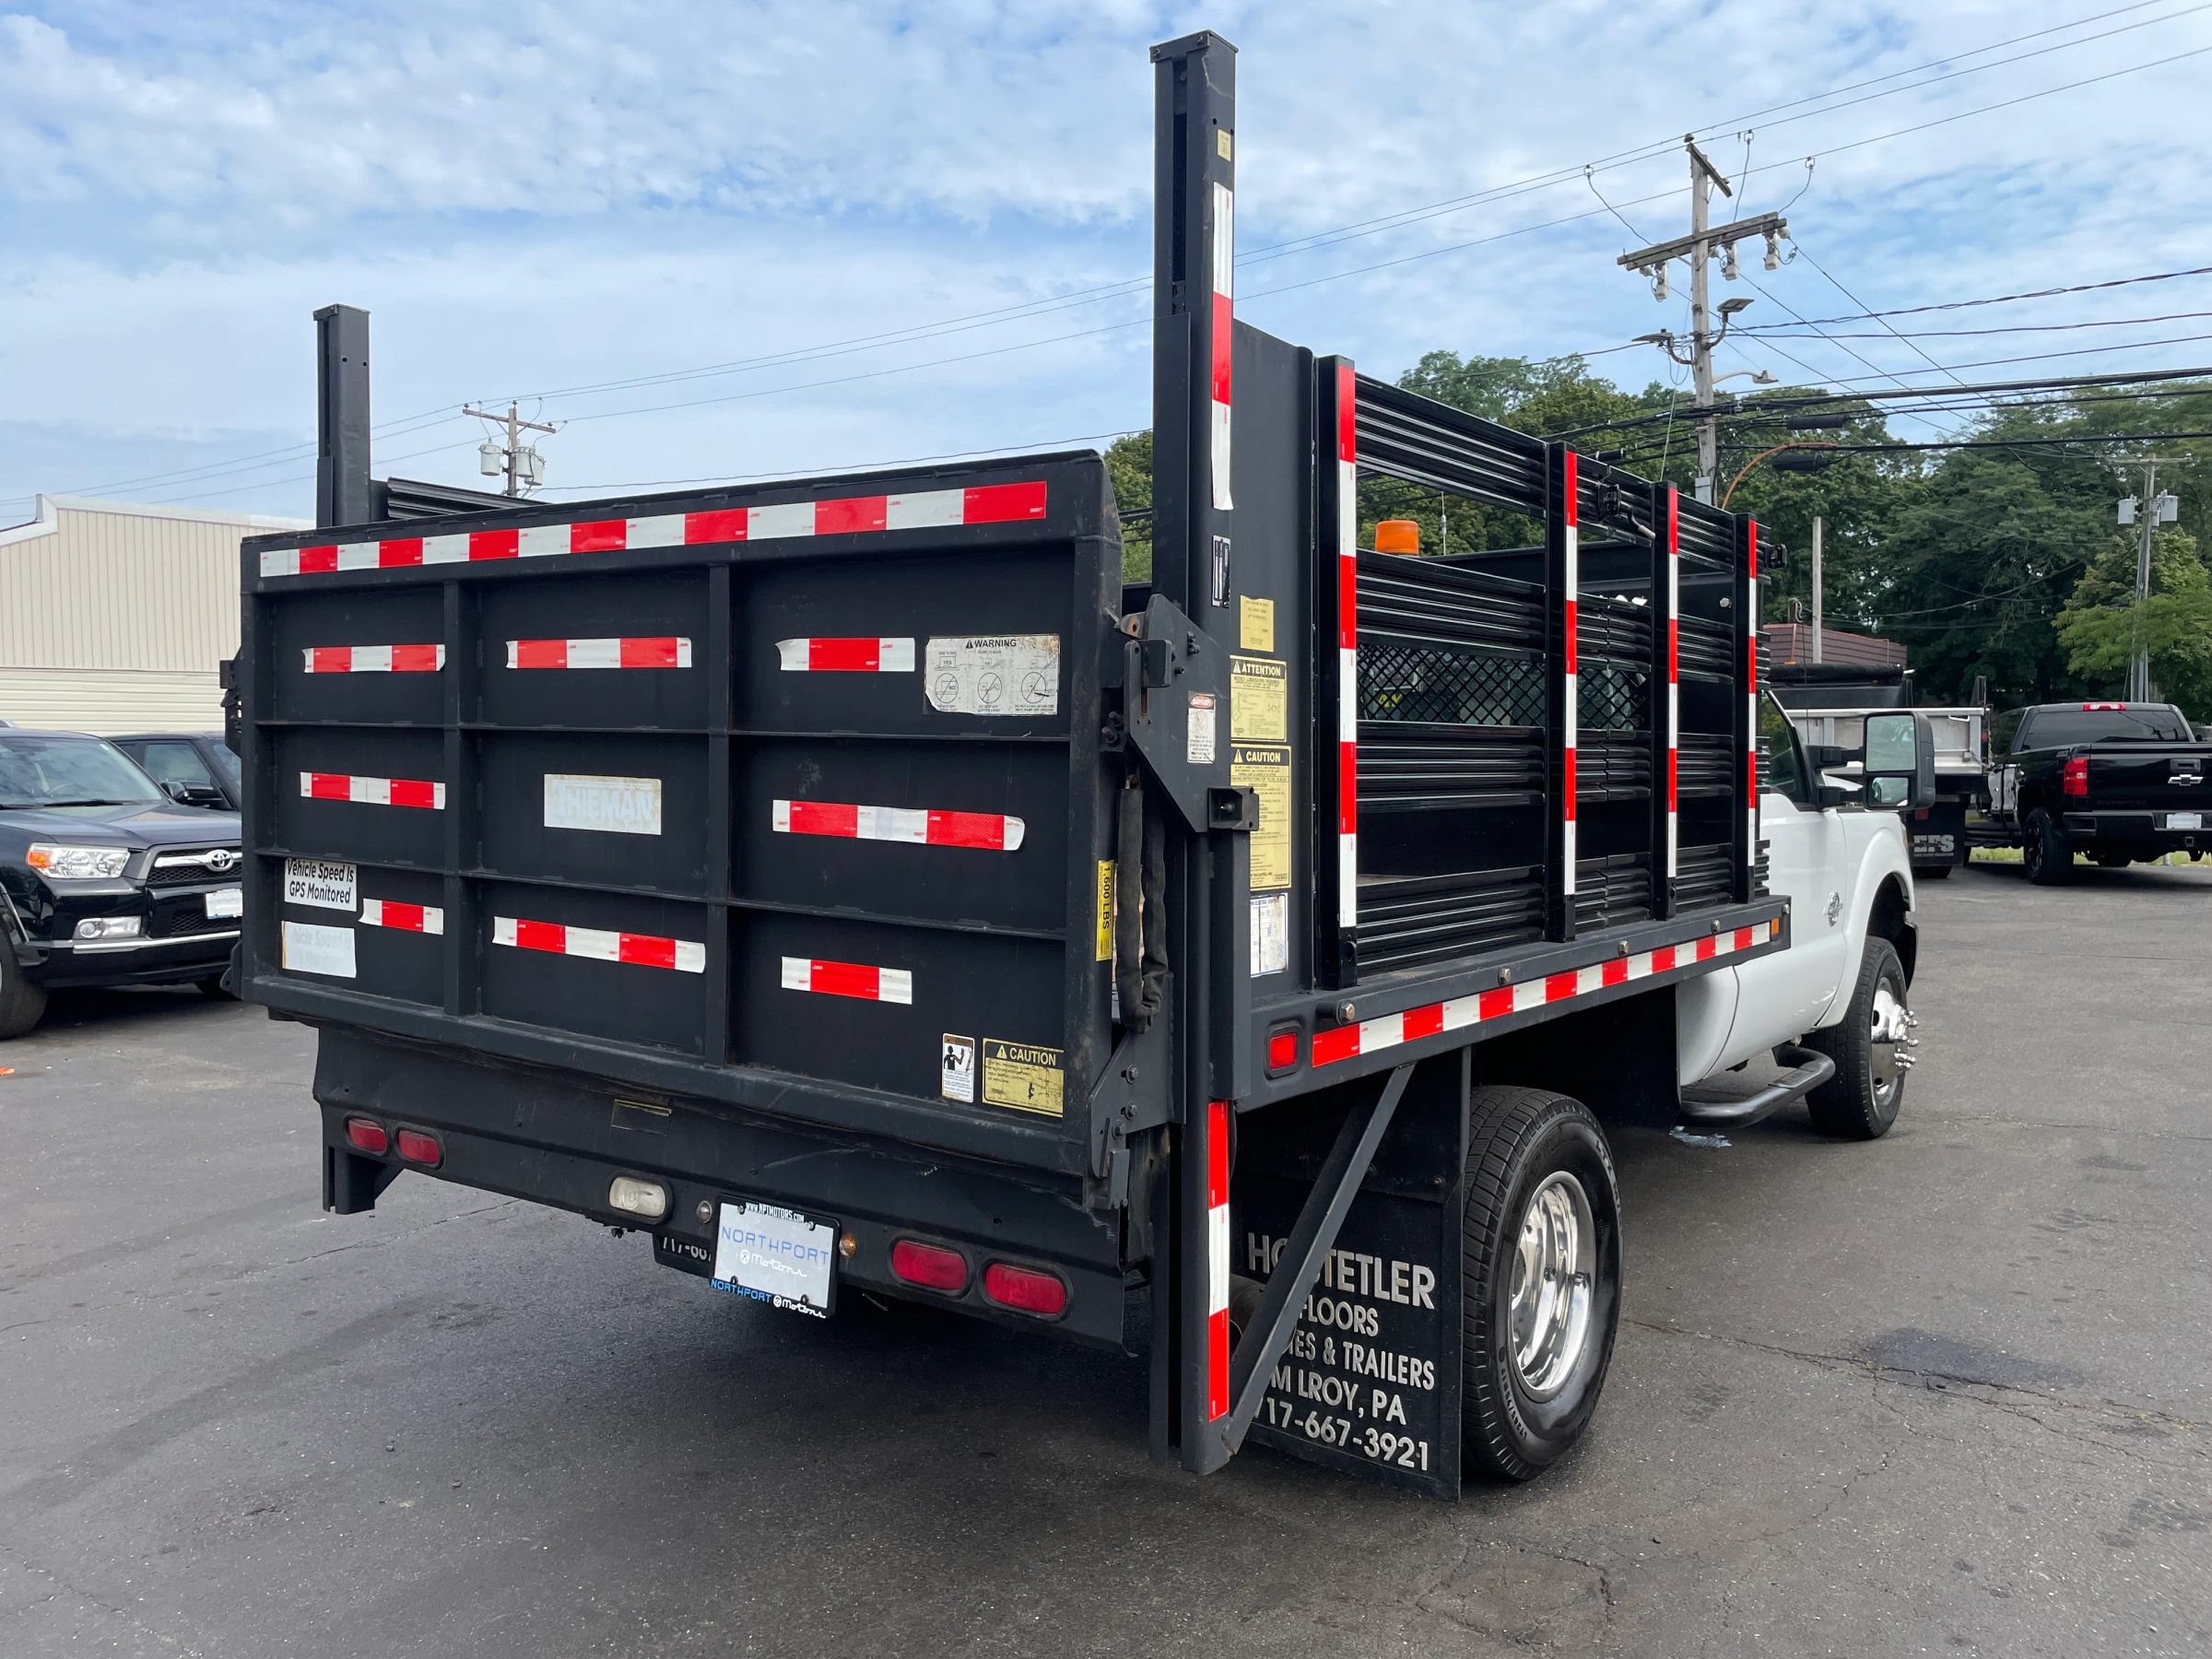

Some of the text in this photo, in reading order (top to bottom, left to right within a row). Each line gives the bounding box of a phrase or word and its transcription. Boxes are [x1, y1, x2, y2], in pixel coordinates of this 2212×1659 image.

[974, 639, 1017, 648] WARNING
[1241, 663, 1281, 677] ATTENTION
[1246, 750, 1281, 763] CAUTION
[287, 857, 354, 884] Vehicle Speed Is
[1102, 866, 1111, 899] 1,600
[289, 880, 351, 904] GPS Monitored
[1009, 1047, 1056, 1066] CAUTION
[722, 1226, 830, 1265] NORTHPORT
[711, 1278, 772, 1304] NORTHPORT
[1322, 1336, 1335, 1366] &
[1343, 1341, 1435, 1391] TRAILERS
[1371, 1389, 1406, 1426] PA
[1253, 1396, 1429, 1471] 17-667-3921
